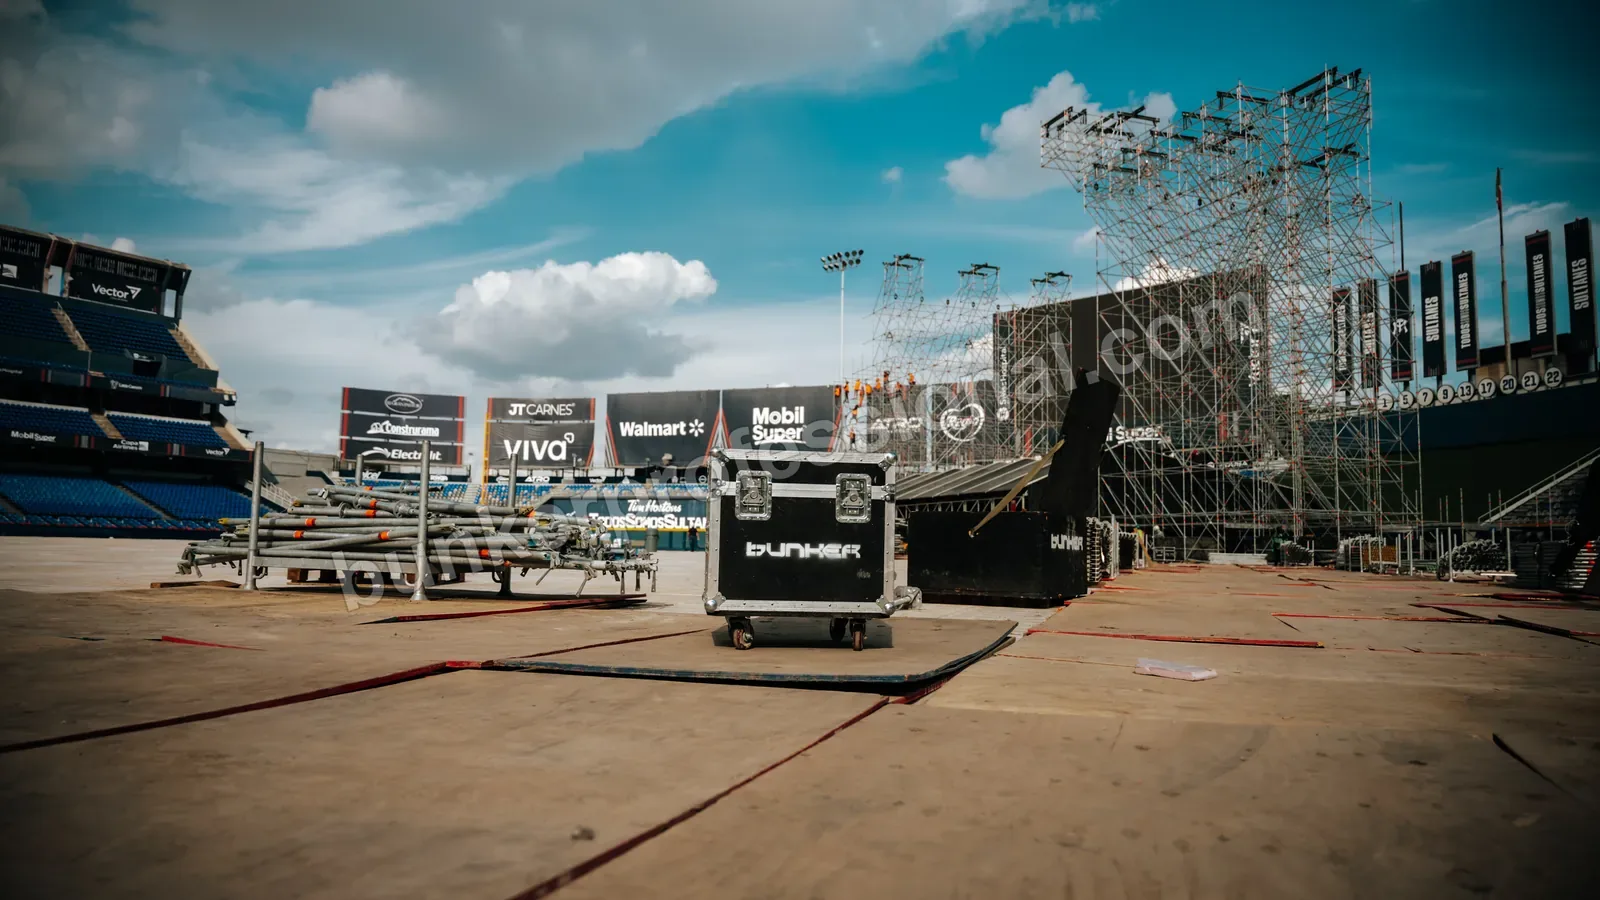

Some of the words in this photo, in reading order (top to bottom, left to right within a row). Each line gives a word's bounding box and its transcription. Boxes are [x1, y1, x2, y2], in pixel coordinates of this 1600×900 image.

[91, 283, 129, 299] Vector
[1571, 257, 1590, 312] SULTANES
[1425, 295, 1440, 343] SULTANES
[1524, 374, 1537, 387] 21
[1547, 371, 1560, 384] 22
[1460, 385, 1471, 397] 13
[1481, 382, 1492, 394] 17
[1502, 378, 1514, 391] 20
[1422, 391, 1428, 402] 7
[1442, 389, 1449, 400] 9
[508, 403, 527, 416] JT
[527, 403, 573, 416] CARNES
[1382, 398, 1388, 408] 1
[752, 406, 805, 425] Mobil
[11, 430, 35, 440] Mobil
[386, 423, 440, 437] Construrama
[619, 421, 687, 437] Walmart
[752, 425, 804, 443] Super
[205, 448, 224, 456] Vector
[391, 449, 442, 460] Electrlit
[627, 499, 644, 512] Tim
[643, 499, 682, 513] Hortons
